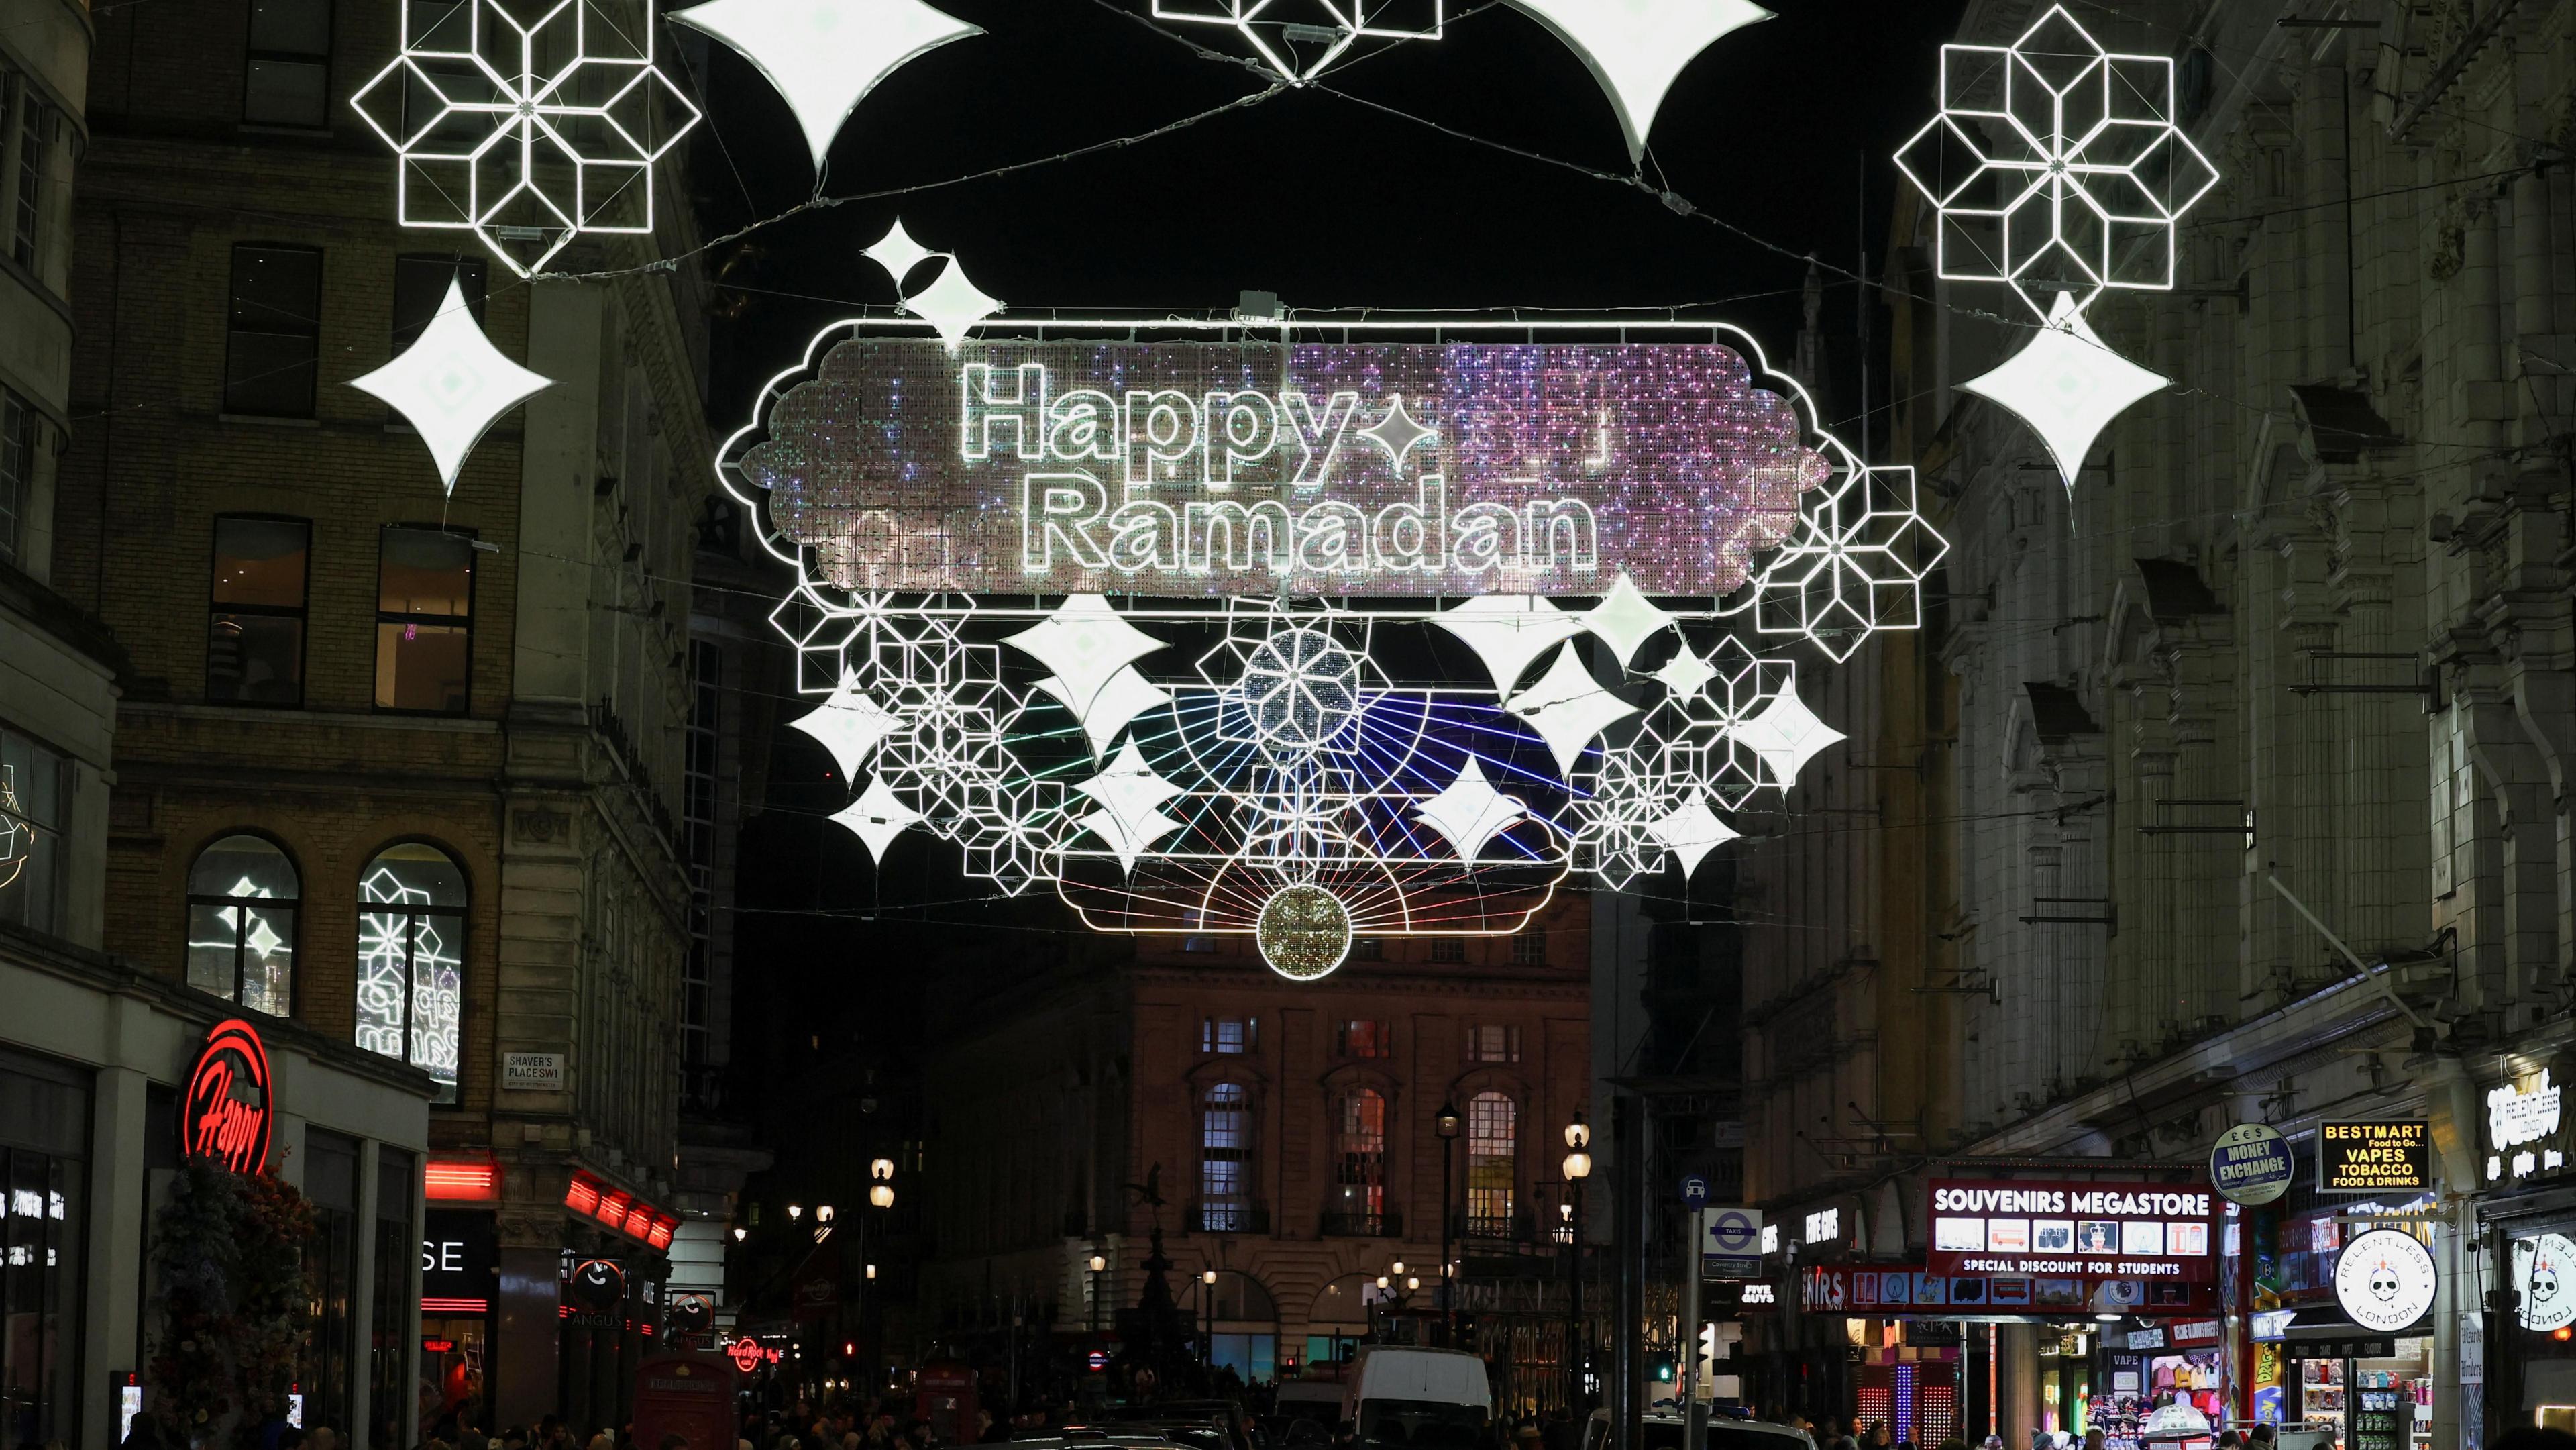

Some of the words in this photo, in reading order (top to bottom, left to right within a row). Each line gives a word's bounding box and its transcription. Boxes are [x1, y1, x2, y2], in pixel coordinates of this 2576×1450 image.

[960, 362, 1358, 486] Happy
[1023, 472, 1598, 572] Ramadan
[510, 1056, 553, 1067] SHAVER'S
[509, 1068, 537, 1078] PLACE
[539, 1068, 558, 1078] SW1
[2506, 1092, 2558, 1121] RELENTLESS
[195, 1059, 264, 1174] Happy
[2326, 1125, 2424, 1139] BESTMART
[2227, 1141, 2270, 1161] MONEY
[2346, 1149, 2406, 1163] VAPES
[2220, 1156, 2286, 1180] EXCHANGE
[2339, 1163, 2413, 1176] TOBACCO
[2333, 1178, 2365, 1186] FOOD
[2367, 1178, 2375, 1186] &
[2377, 1177, 2420, 1186] DRINKS
[1935, 1188, 2065, 1213] SOUVENIRS
[2071, 1192, 2210, 1216] MEGASTORE
[1805, 1212, 1821, 1245] FIVE
[1821, 1208, 1838, 1241] GUYS
[2341, 1237, 2429, 1278] RELENTLESS
[1964, 1259, 2015, 1272] SPECIAL
[2019, 1260, 2083, 1273] DISCOUNT
[2088, 1261, 2112, 1274] FOR
[2118, 1262, 2180, 1274] STUDENTS
[1745, 1284, 1772, 1294] FIVE
[1741, 1294, 1775, 1304] GUYS
[572, 1314, 623, 1327] ANGUS
[2356, 1302, 2418, 1325] LONDON
[674, 1335, 710, 1345] ANGUS
[2461, 1327, 2482, 1344] Wizards
[727, 1345, 748, 1356] Hard
[748, 1345, 763, 1359] Rock
[2114, 1355, 2138, 1365] VAPE
[2461, 1358, 2482, 1377] Wonders
